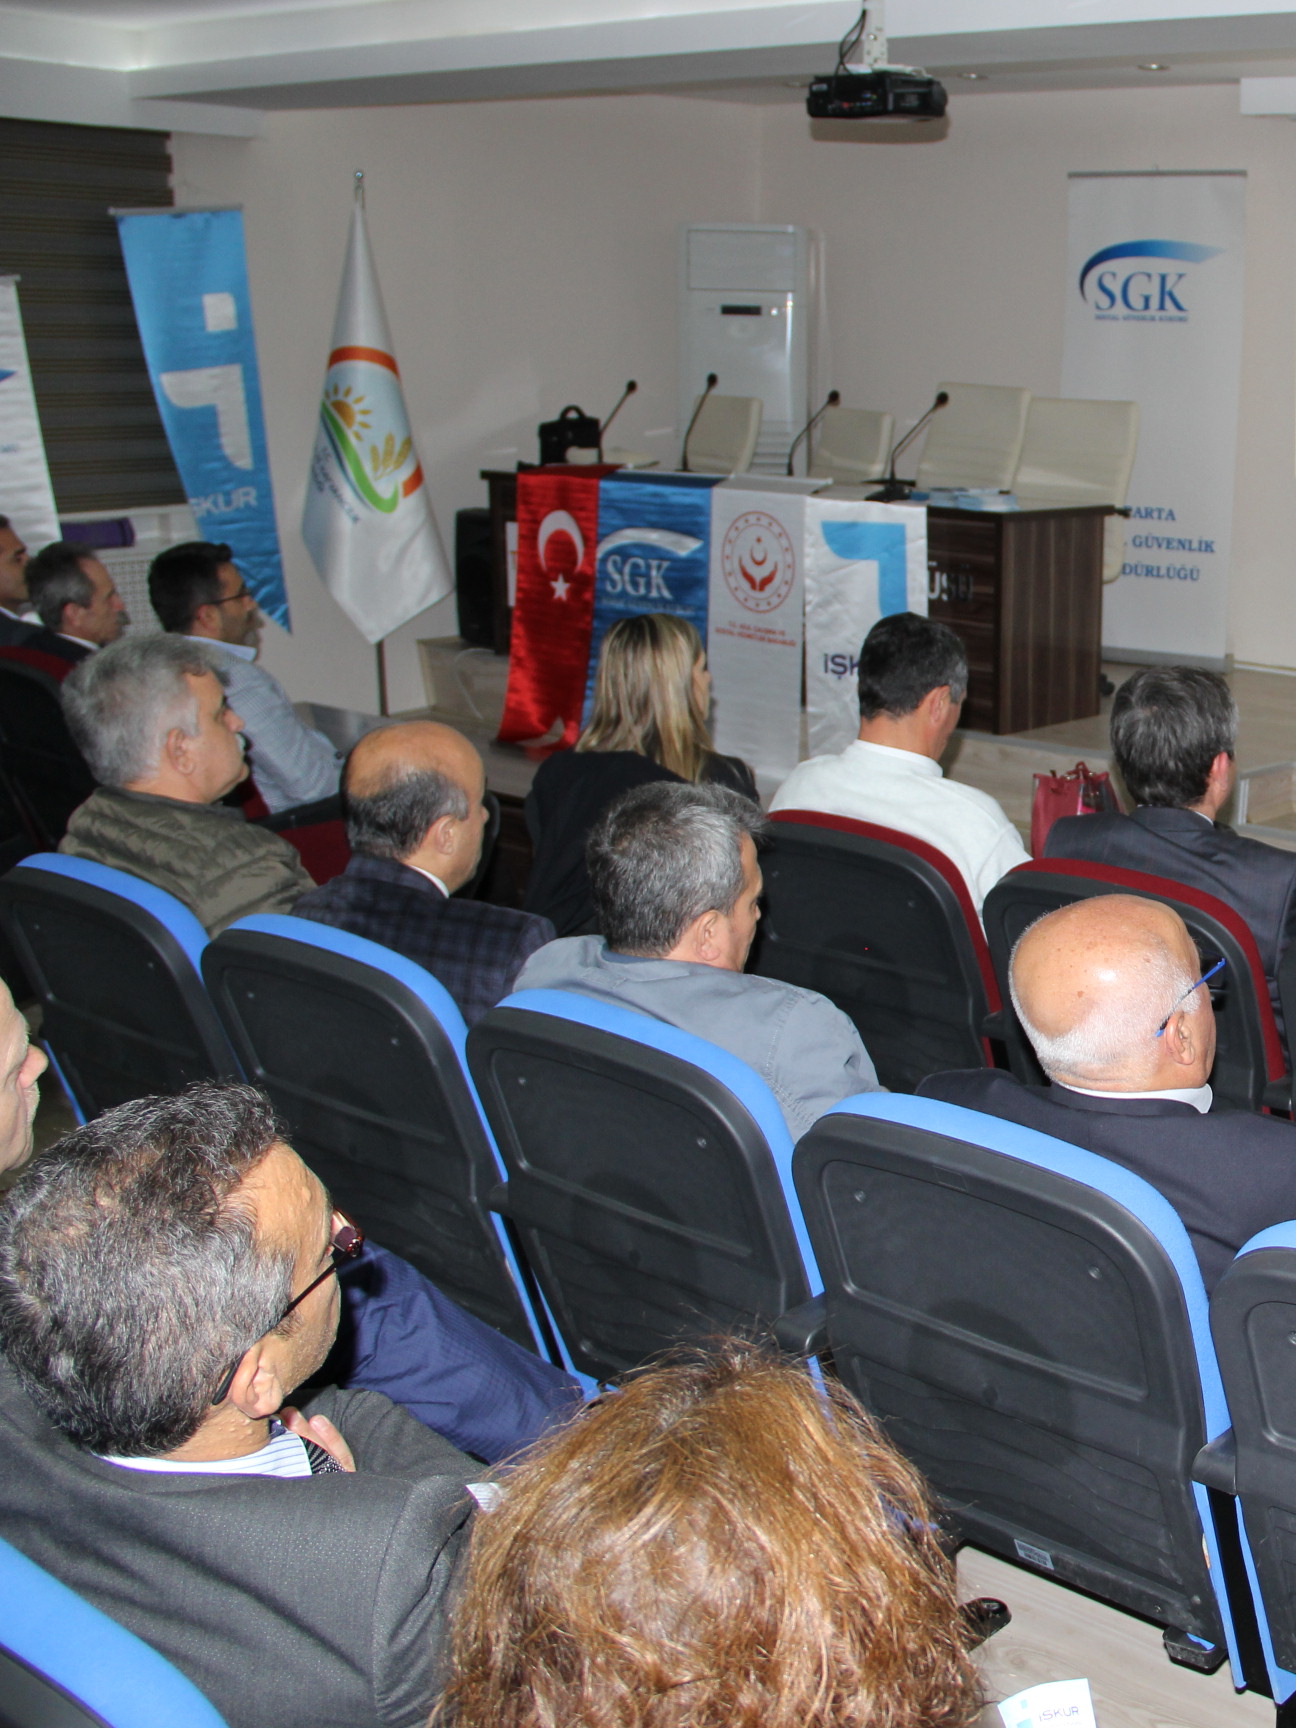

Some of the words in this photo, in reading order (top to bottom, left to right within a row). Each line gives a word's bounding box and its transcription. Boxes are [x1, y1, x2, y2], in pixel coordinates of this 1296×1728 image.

[1095, 270, 1189, 312] SGK
[1132, 533, 1216, 553] GÜVENLİK
[605, 554, 673, 600] SGK
